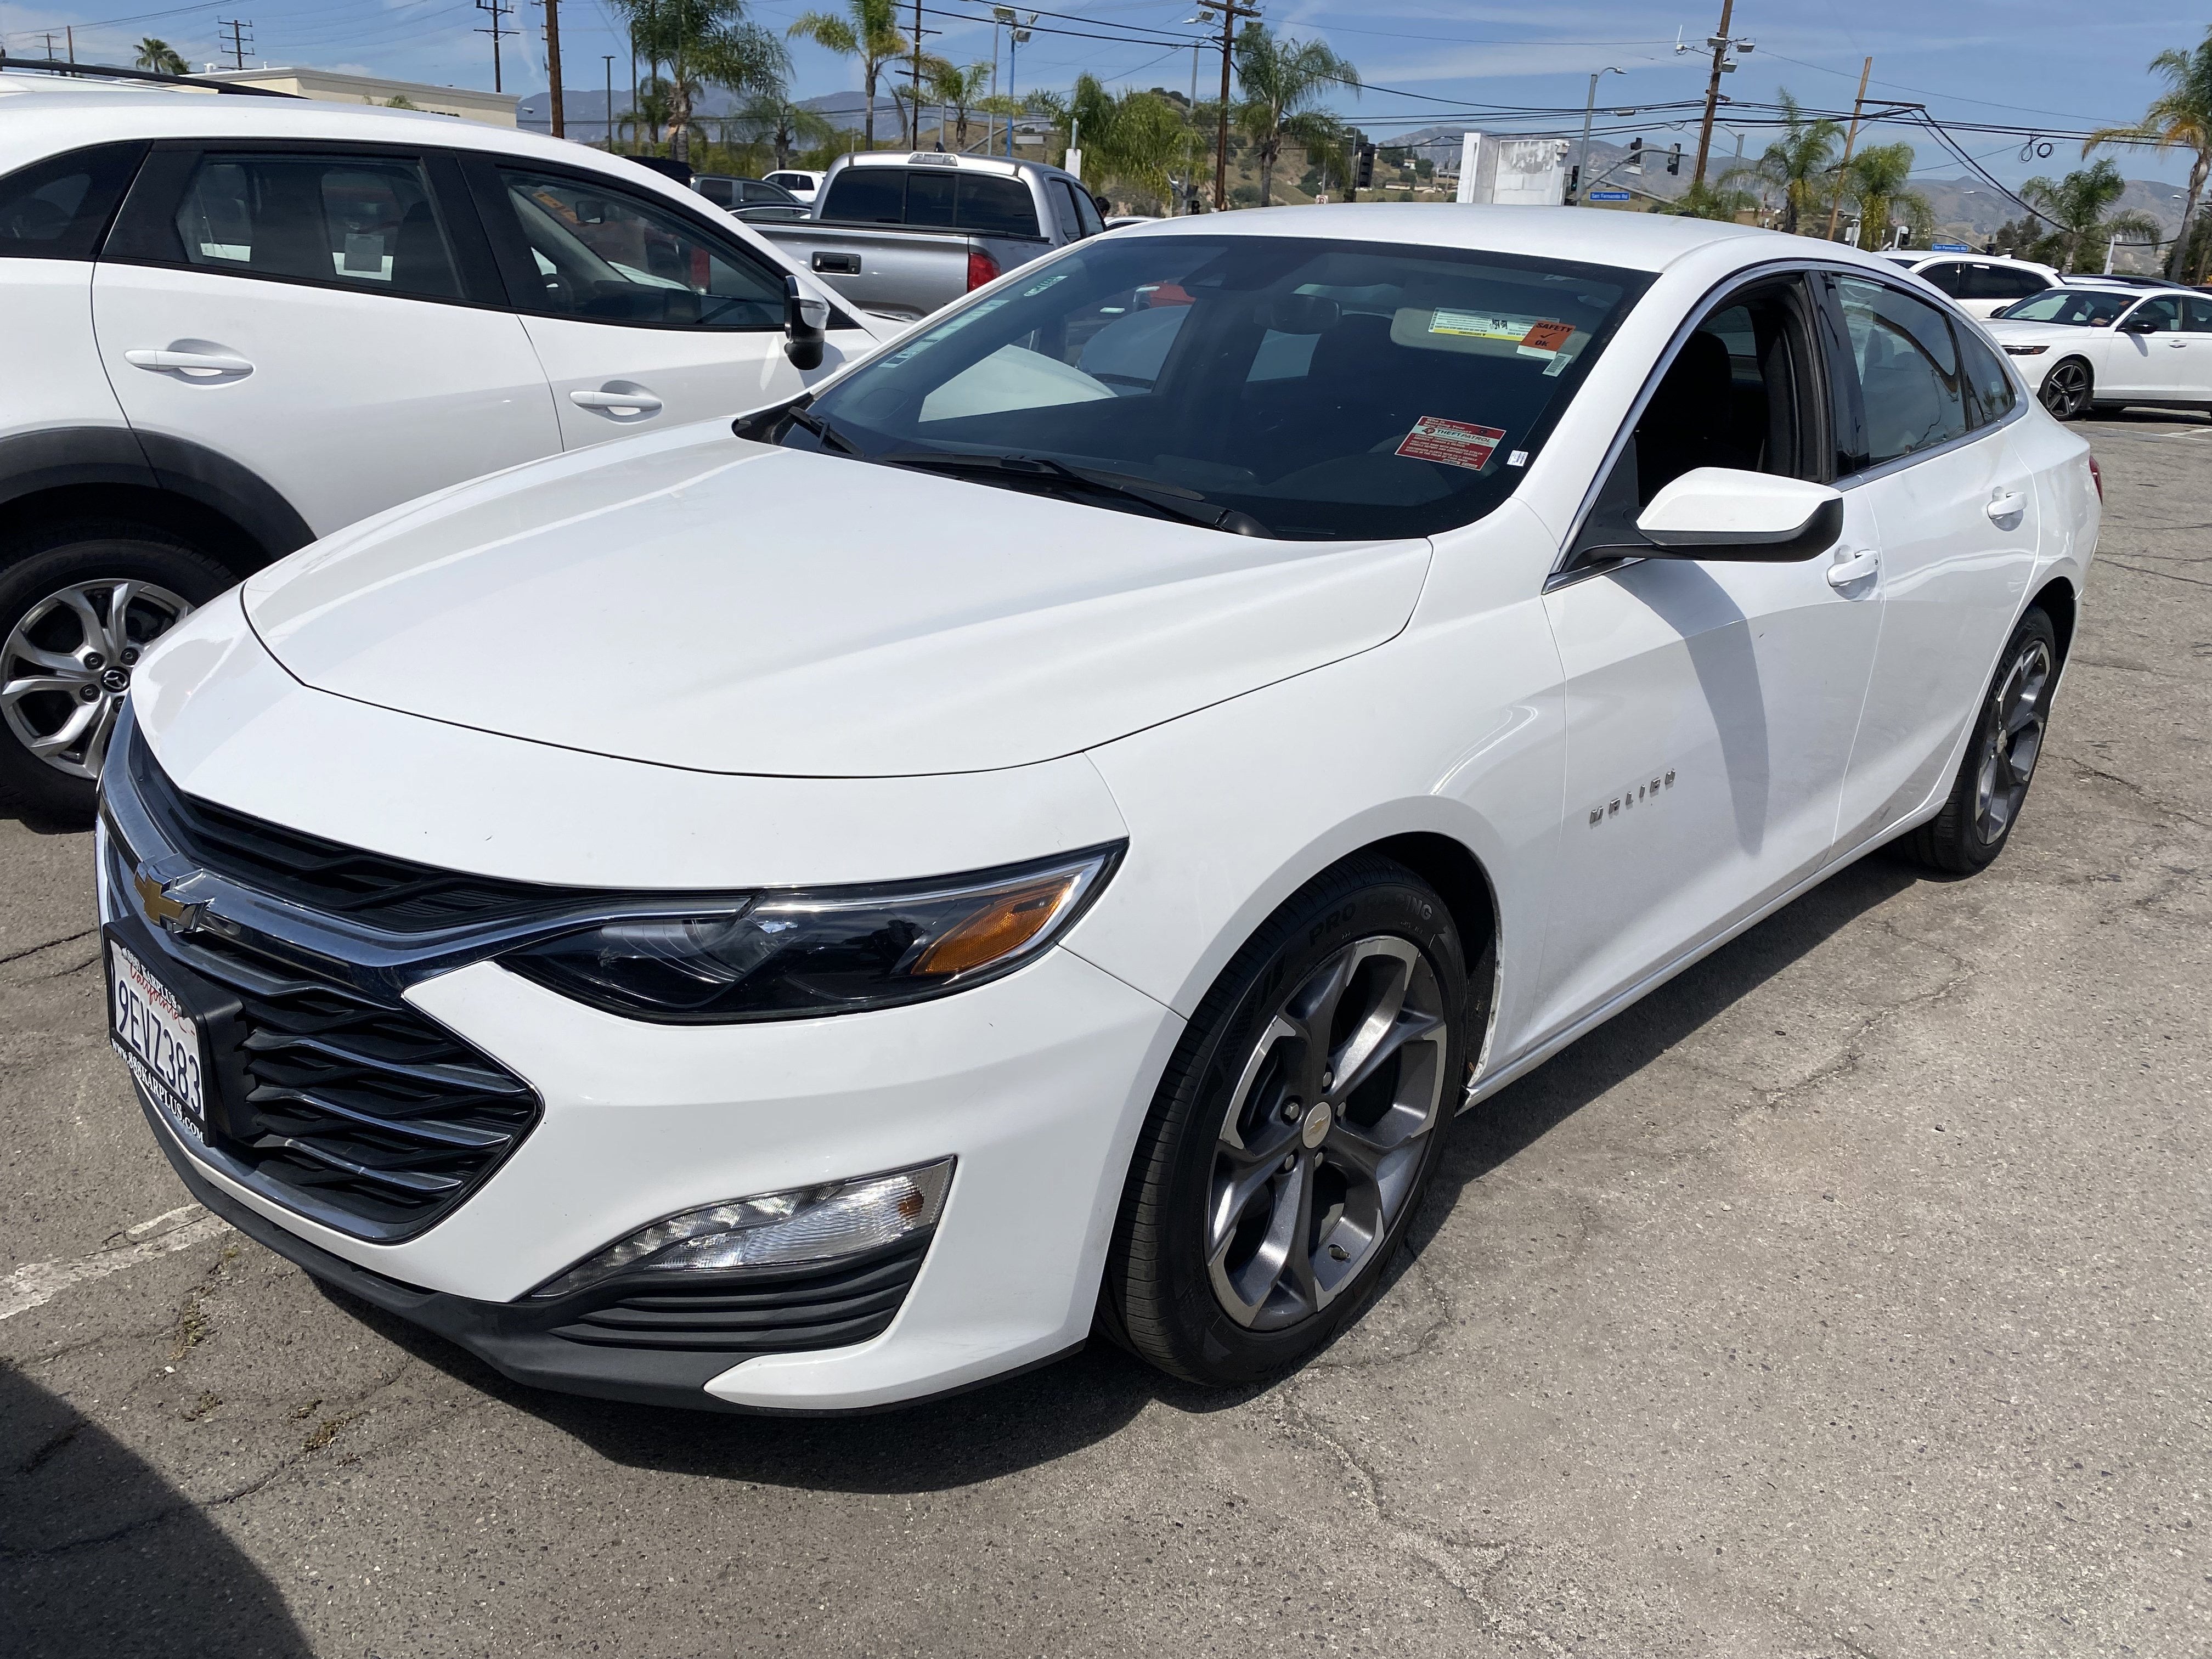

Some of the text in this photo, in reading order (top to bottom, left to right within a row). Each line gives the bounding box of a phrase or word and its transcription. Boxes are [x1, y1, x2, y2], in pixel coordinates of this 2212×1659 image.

[1536, 323, 1572, 332] SAFETY
[1589, 768, 1675, 824] MALIBU
[1309, 902, 1357, 947] PRO
[140, 964, 177, 1009] KARPLUS
[119, 980, 201, 1115] 9EVZ383
